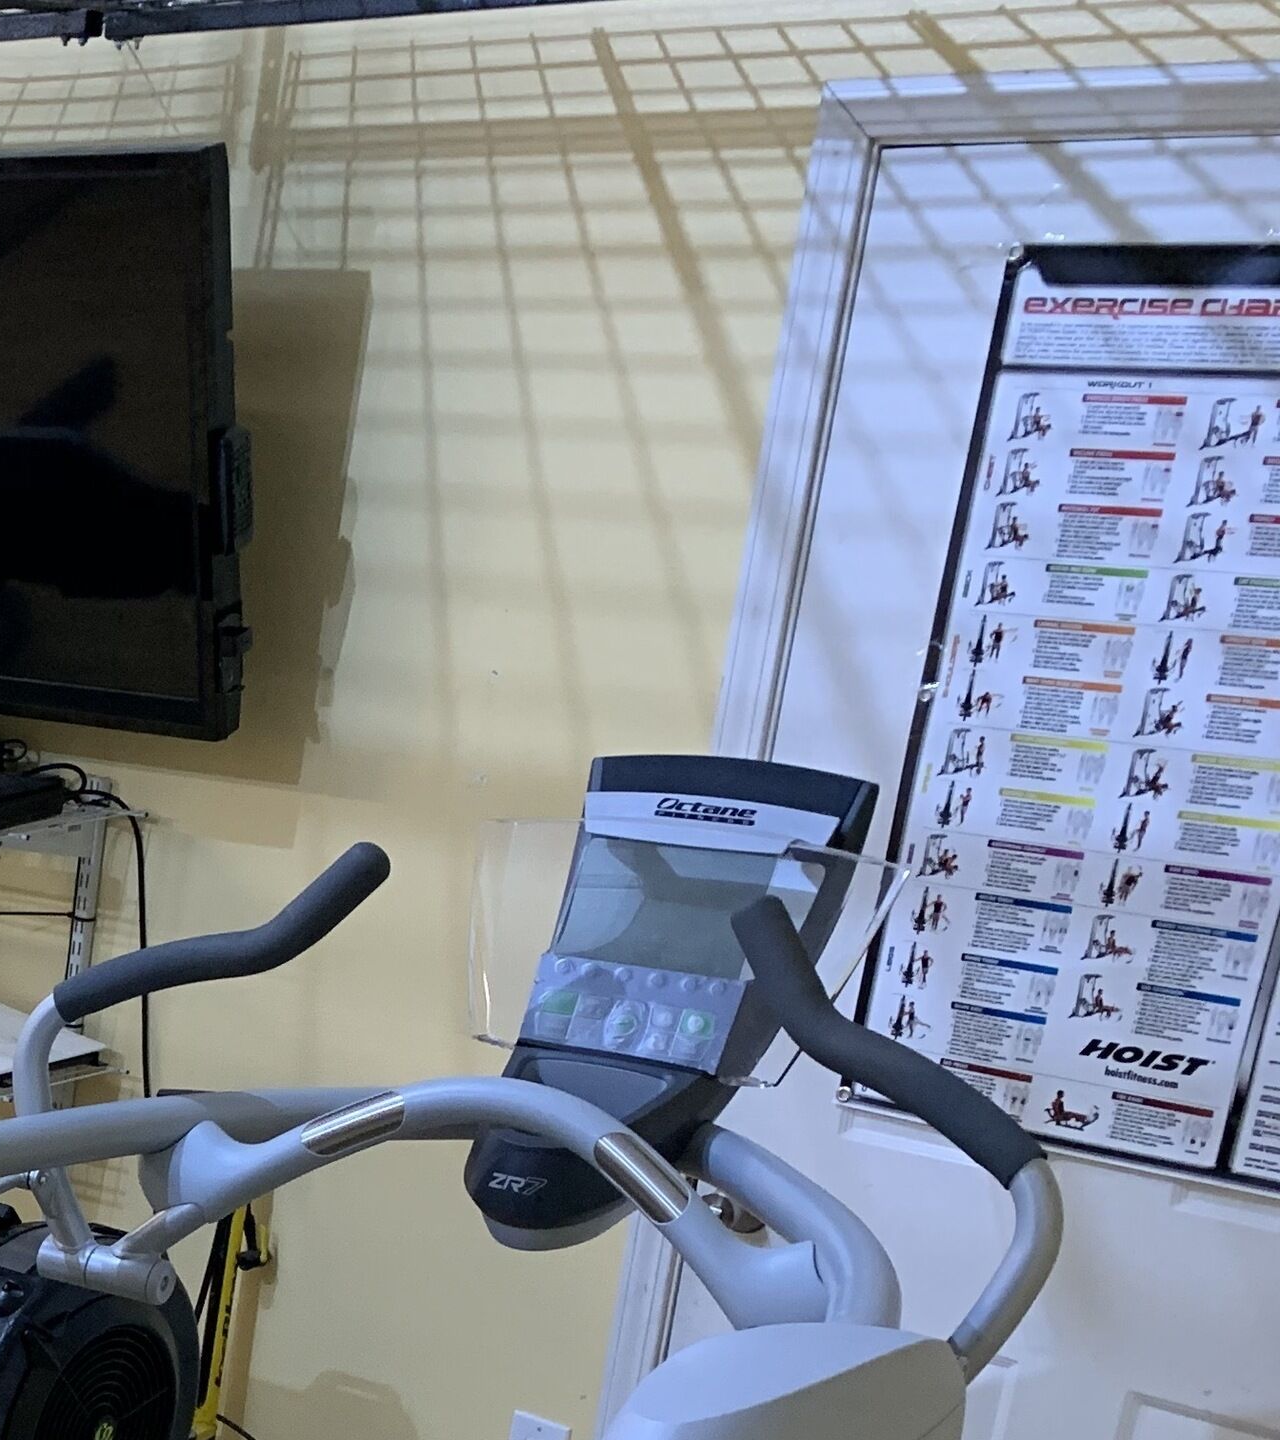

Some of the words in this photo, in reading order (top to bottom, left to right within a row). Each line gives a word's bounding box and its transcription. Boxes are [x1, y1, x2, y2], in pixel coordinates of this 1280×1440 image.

[1023, 296, 1194, 320] EXERCISE
[657, 797, 757, 819] Octane
[1079, 1038, 1210, 1076] HOIST
[1104, 1065, 1179, 1089] hoistfitness.com
[488, 1172, 548, 1196] ZR7
